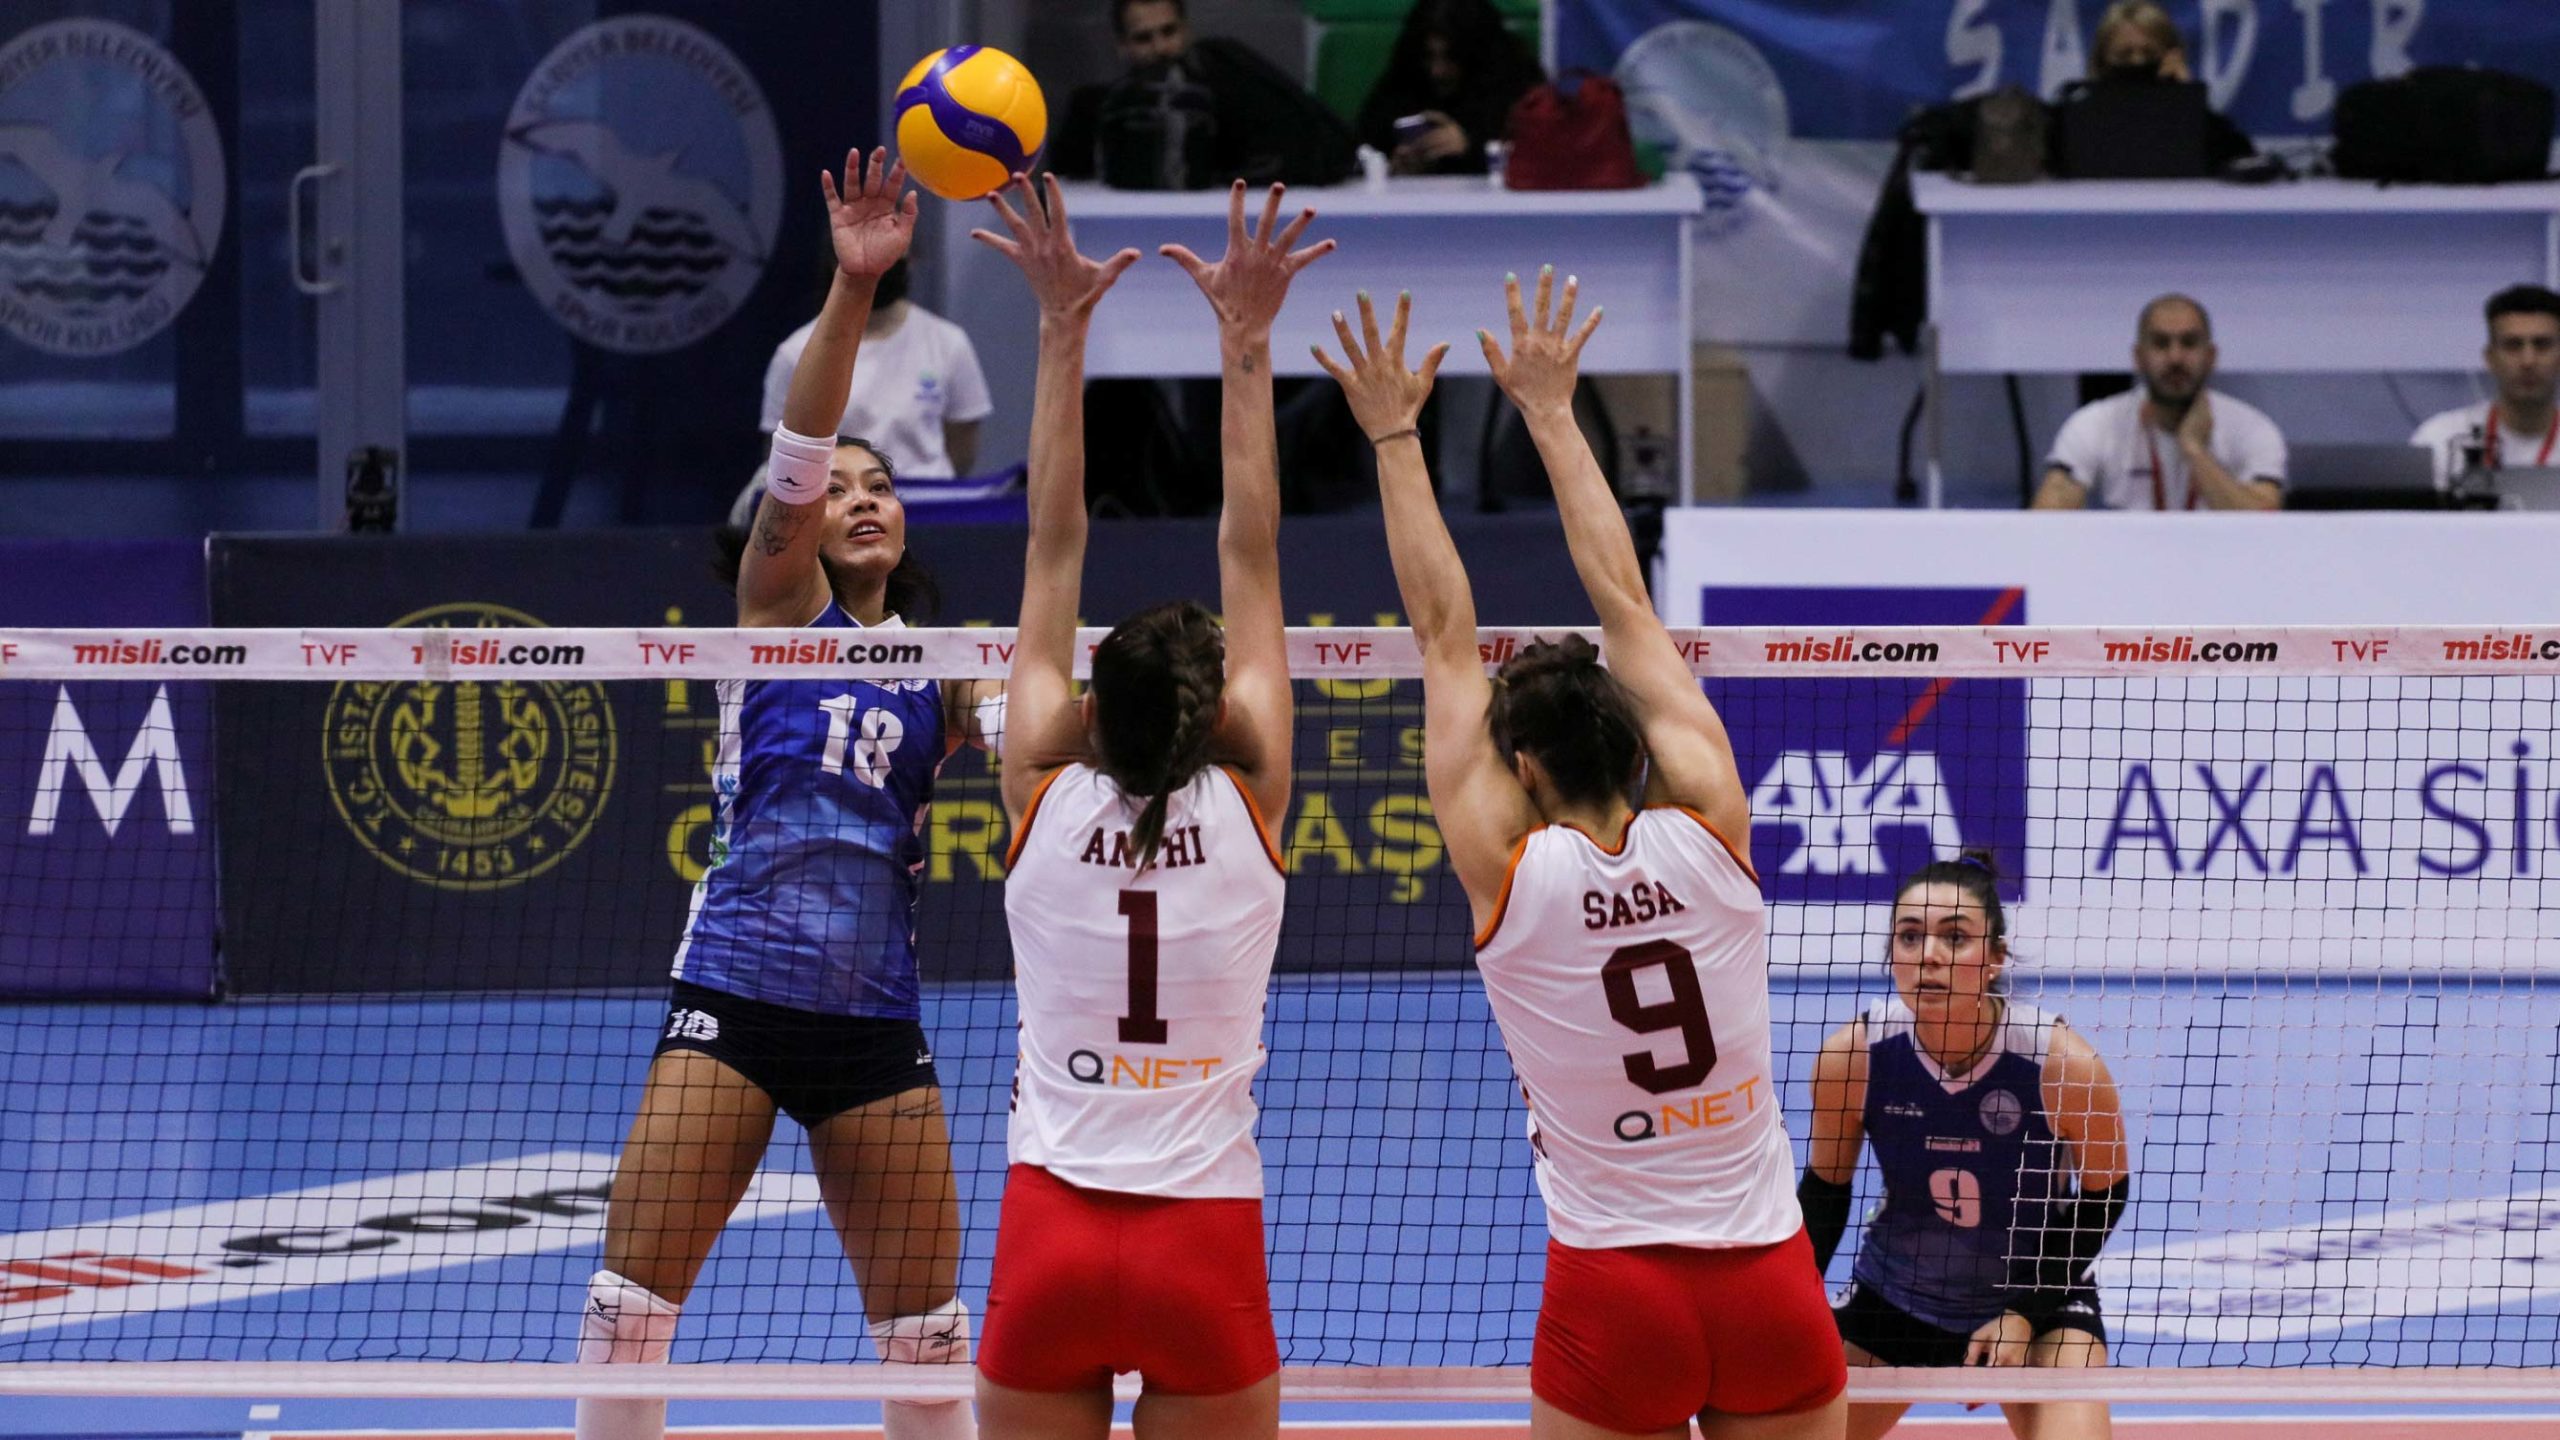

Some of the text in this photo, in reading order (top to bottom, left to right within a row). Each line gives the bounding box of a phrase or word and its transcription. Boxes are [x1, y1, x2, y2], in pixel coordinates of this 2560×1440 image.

[964, 119, 995, 138] FIVB
[74, 639, 247, 665] misli.com
[301, 645, 358, 667] TVF
[639, 643, 696, 665] TVF
[750, 639, 923, 664] misli.com
[977, 643, 1015, 665] TV
[1315, 643, 1372, 665] TVF
[1673, 641, 1711, 663] VF
[1764, 637, 1939, 662] misli.com
[1993, 642, 2050, 663] TVF
[2104, 637, 2278, 662] misli.com
[2332, 641, 2389, 662] TVF
[819, 693, 904, 790] 18
[1748, 750, 1963, 875] AXA
[2095, 740, 2560, 876] AXA Sİ
[1080, 825, 1206, 870] ANHI
[1583, 880, 1686, 931] SASA
[1117, 889, 1168, 1045] 1
[1601, 938, 1718, 1095] 9
[1613, 1074, 1761, 1143] QNET
[1928, 1168, 1982, 1229] 9
